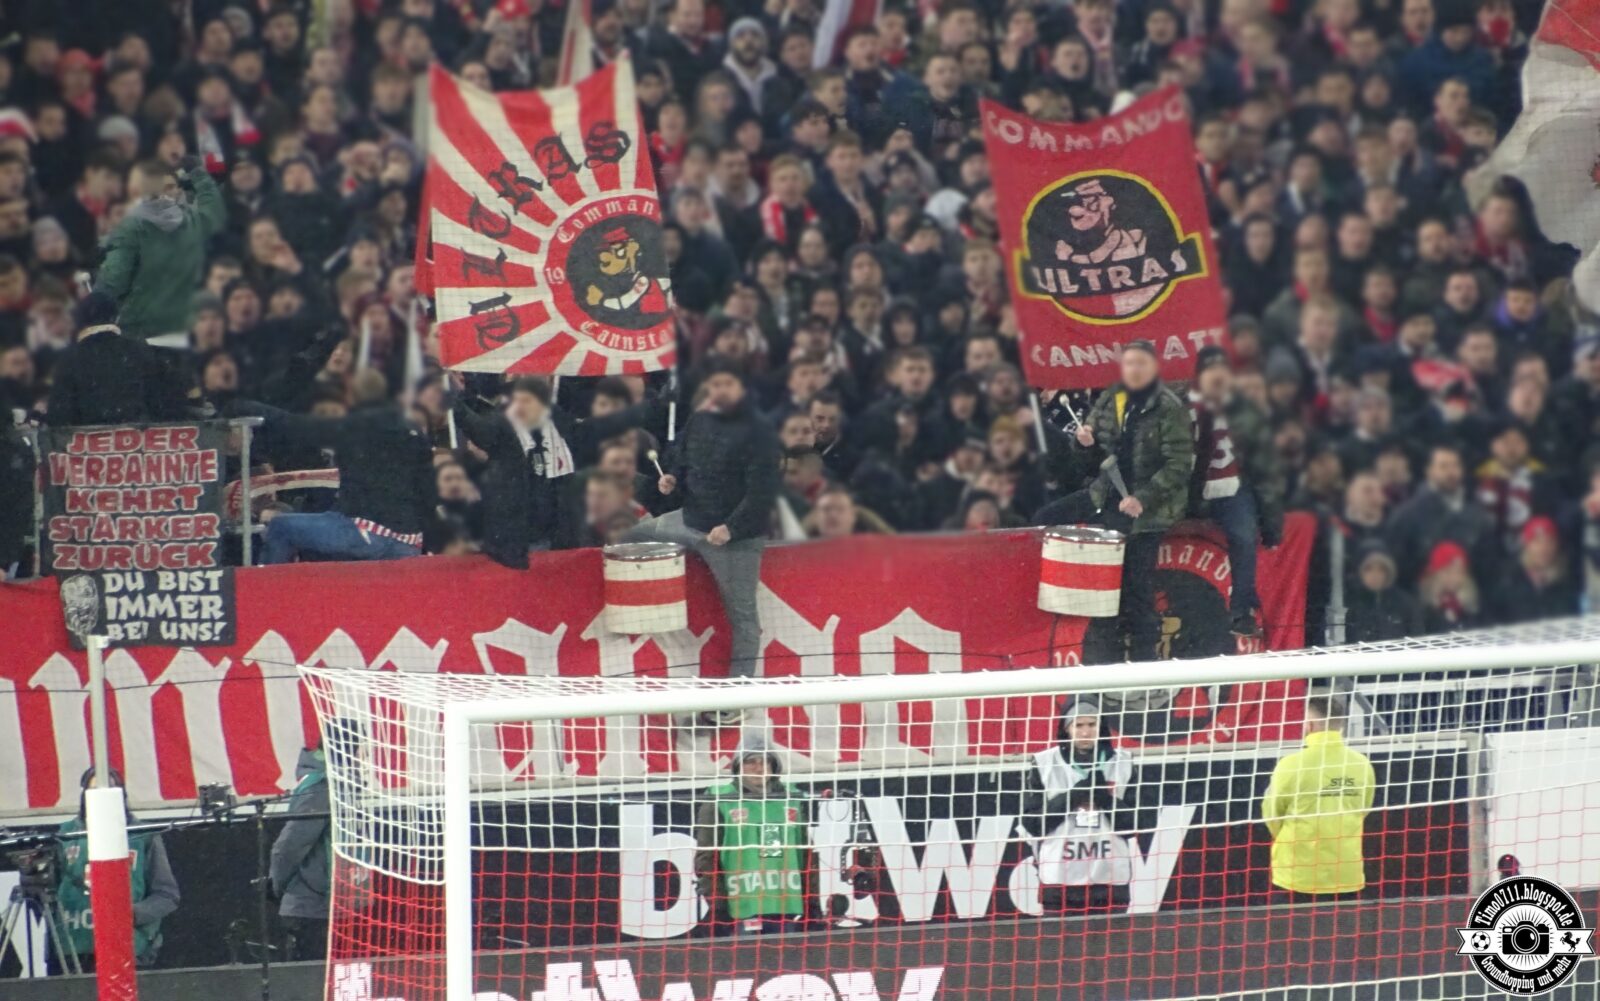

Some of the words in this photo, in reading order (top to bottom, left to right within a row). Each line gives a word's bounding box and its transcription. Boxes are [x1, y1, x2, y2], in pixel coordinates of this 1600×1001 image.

[556, 199, 664, 243] Comman
[1032, 249, 1188, 294] ULTRAS
[1031, 327, 1224, 368] CANNATT
[67, 426, 200, 453] JEDER
[48, 449, 219, 486] VERBANNTE
[65, 484, 204, 514] KEHRT
[53, 541, 218, 571] ZURÜCK
[102, 571, 145, 593] DU
[157, 570, 224, 592] BIST
[105, 595, 226, 620] IMMER
[106, 621, 149, 640] BEI
[160, 621, 228, 641] UNS!
[1062, 840, 1112, 861] SMF
